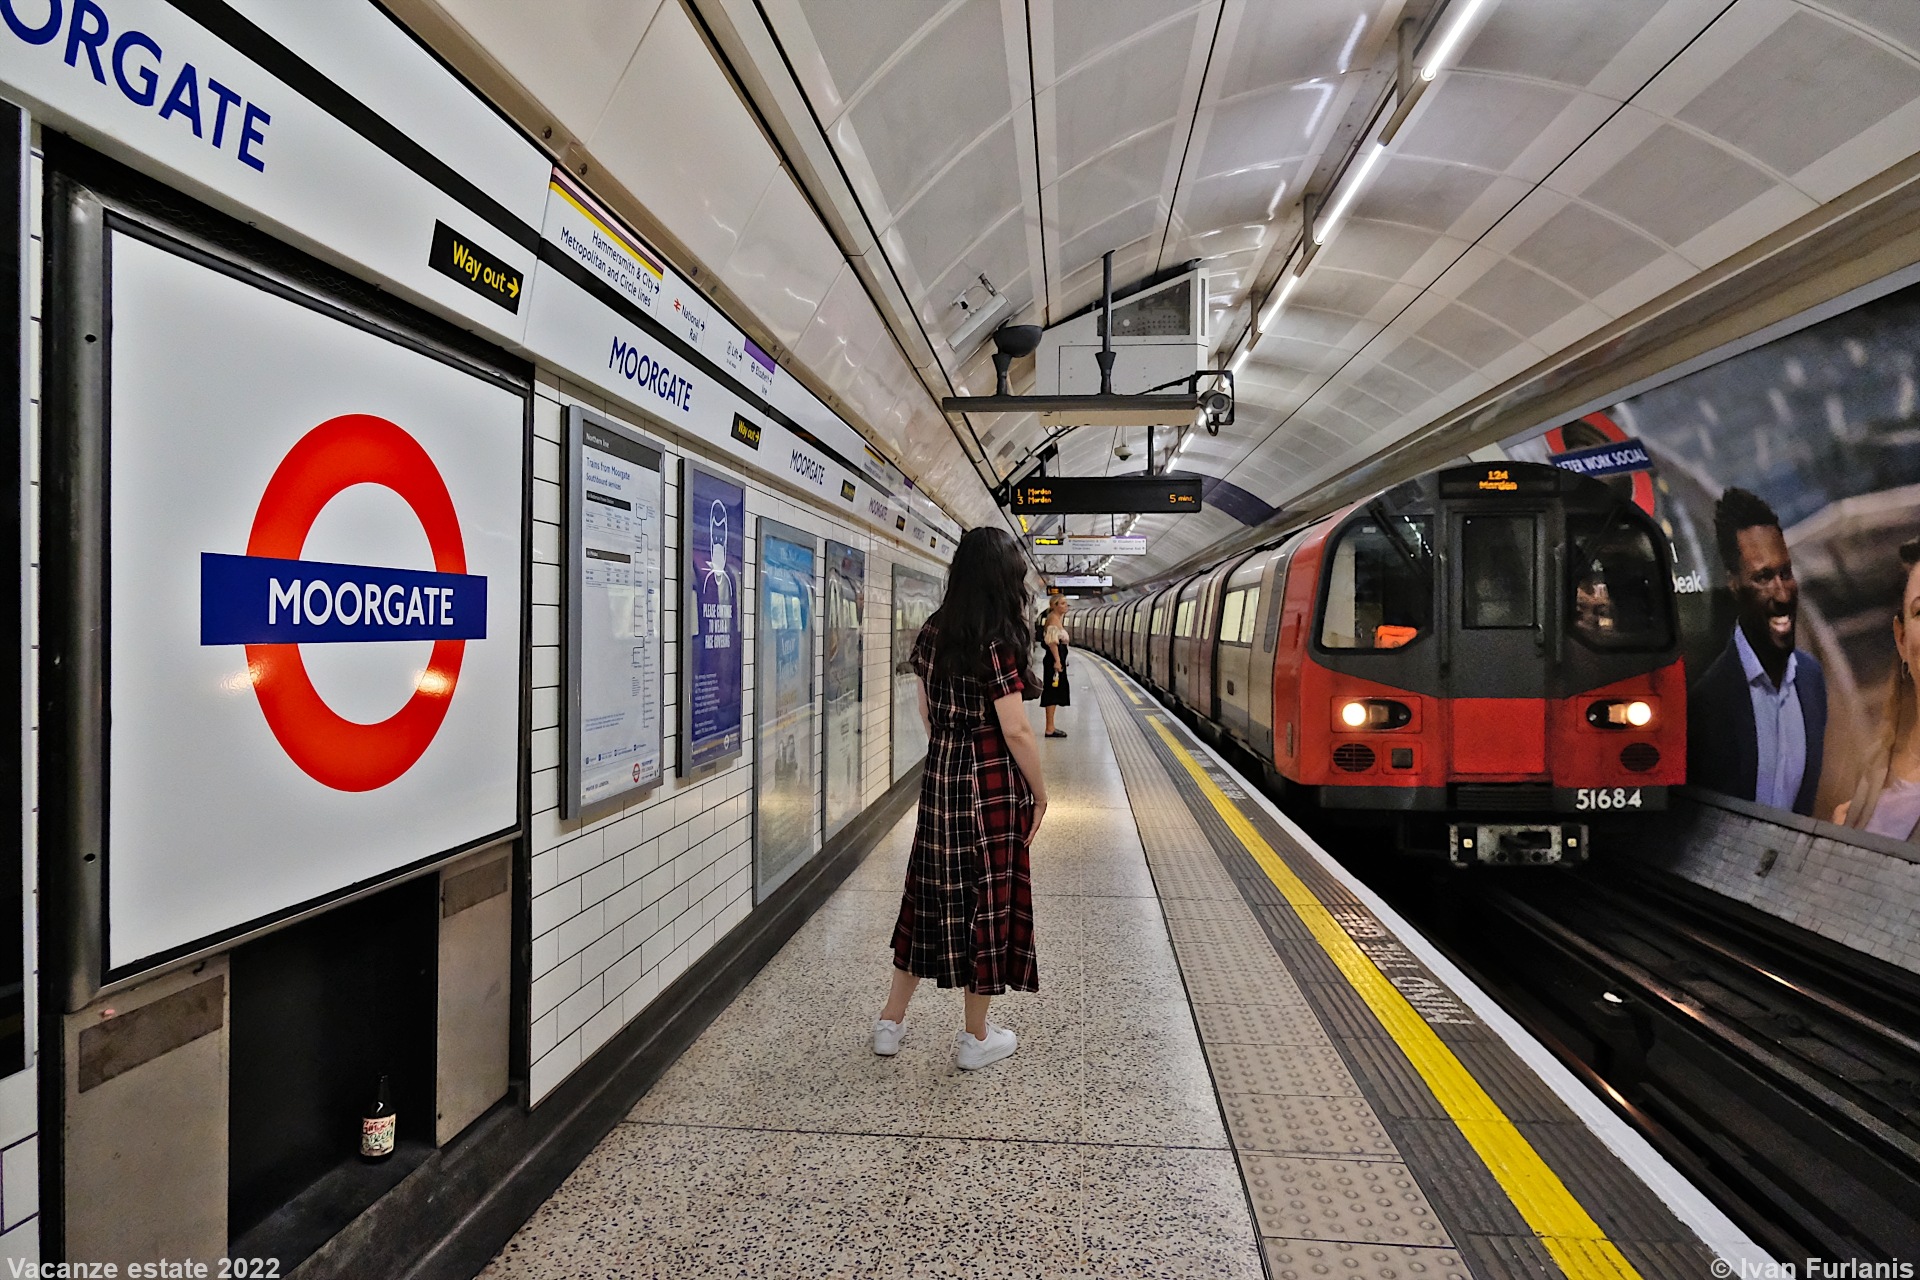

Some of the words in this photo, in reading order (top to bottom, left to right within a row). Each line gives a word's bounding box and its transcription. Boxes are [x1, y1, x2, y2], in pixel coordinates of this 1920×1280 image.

[452, 240, 483, 281] Way
[483, 261, 507, 293] out
[560, 226, 606, 273] Metropolitan
[607, 266, 619, 282] and
[620, 274, 636, 296] Circle
[637, 287, 651, 307] lines
[592, 230, 635, 276] Hammersmith
[636, 268, 641, 280] &
[642, 272, 654, 293] City
[681, 304, 701, 329] National
[689, 328, 698, 343] Rail
[609, 335, 693, 412] MOORGATE
[738, 419, 749, 440] Way
[748, 426, 757, 442] out
[586, 457, 600, 471] Trains
[600, 460, 611, 474] from
[611, 463, 631, 481] Moorgate
[789, 449, 826, 486] MOORGATE
[1582, 454, 1614, 471] WORK
[1611, 448, 1649, 465] SOCIAL
[1027, 487, 1051, 496] Morden
[1479, 480, 1518, 491] Morden
[1027, 495, 1052, 504] Morden
[1169, 494, 1176, 503] 5
[269, 578, 454, 626] MOORGATE
[1576, 789, 1643, 810] 51684
[1357, 942, 1420, 971] THE
[1390, 976, 1476, 1025] MIND
